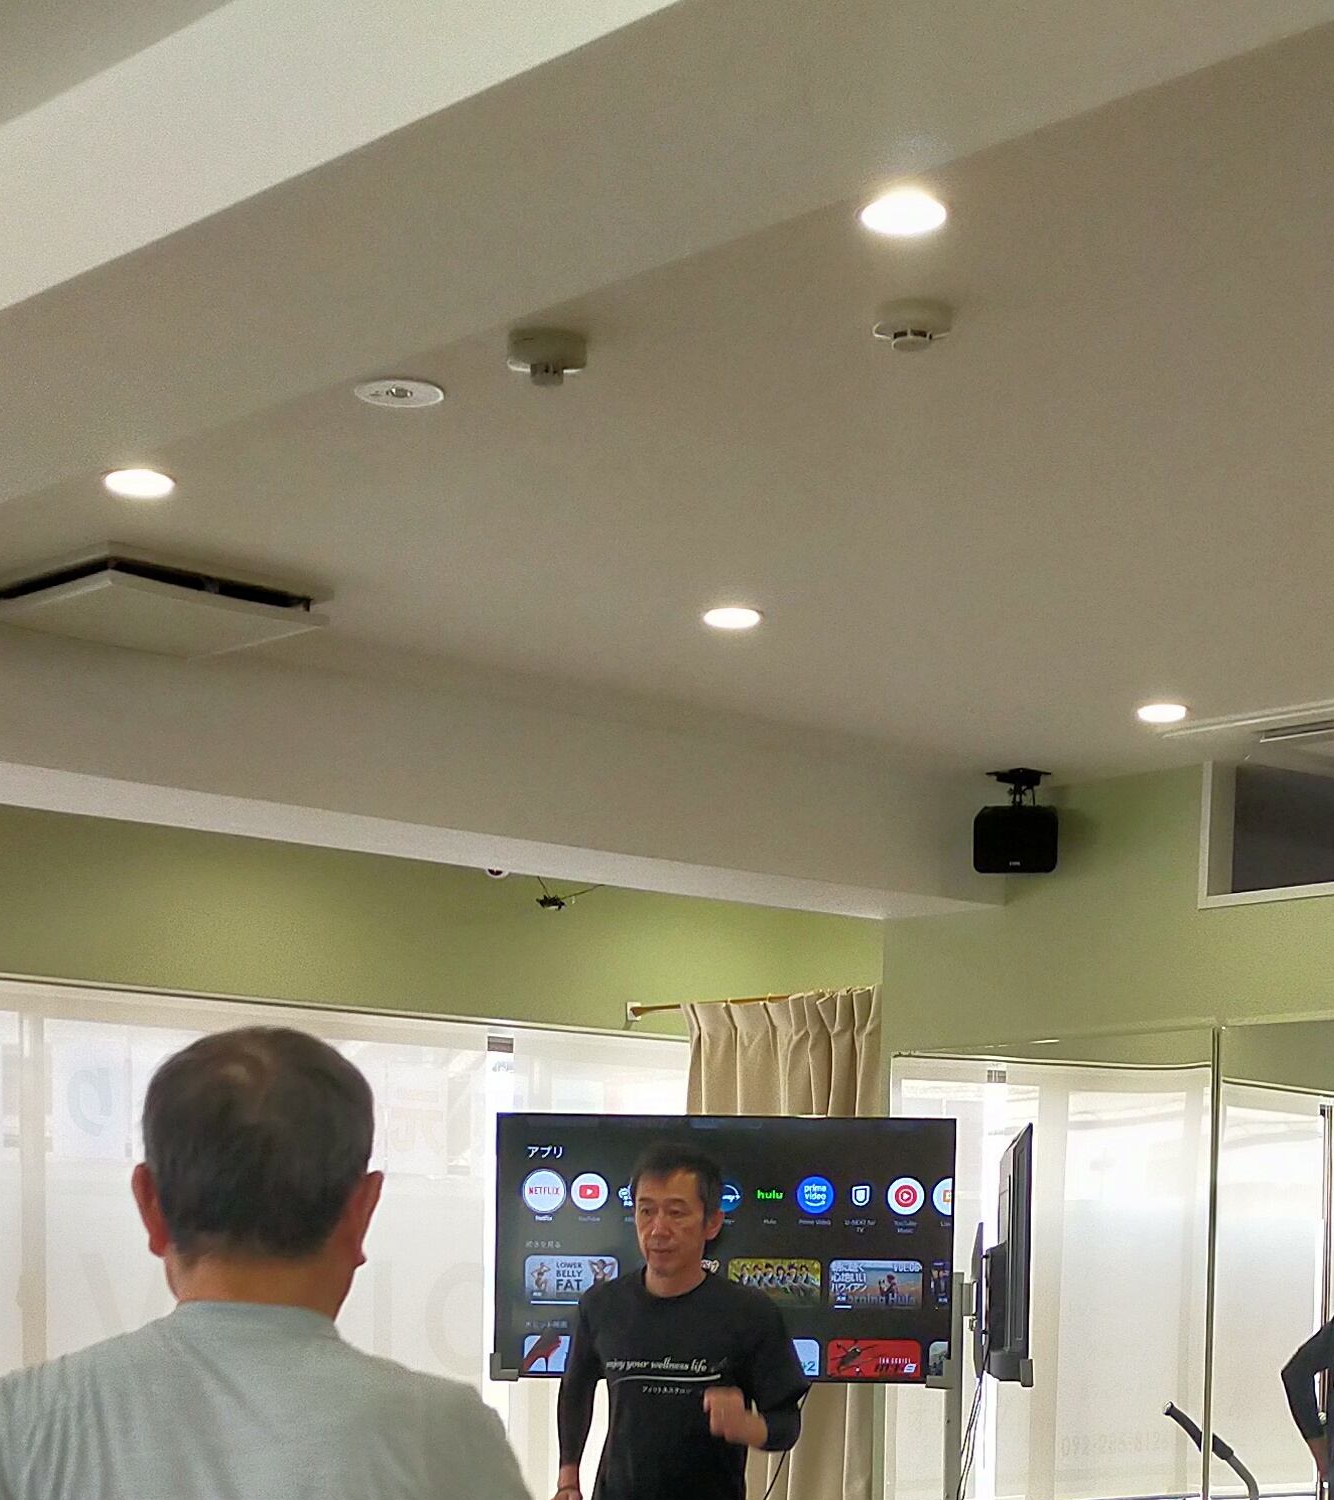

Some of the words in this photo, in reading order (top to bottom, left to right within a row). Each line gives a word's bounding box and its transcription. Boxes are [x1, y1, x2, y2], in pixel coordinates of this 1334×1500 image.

[527, 1145, 563, 1159] アプリ
[528, 1186, 560, 1195] NETFLIX
[756, 1188, 784, 1200] hulu
[803, 1183, 827, 1194] prime
[804, 1192, 827, 1200] video
[556, 1270, 582, 1278] BELLY
[556, 1279, 583, 1291] FAT
[831, 1283, 867, 1292] ハワイアン
[626, 1360, 650, 1371] your
[651, 1356, 689, 1370] wellness
[691, 1357, 707, 1372] life
